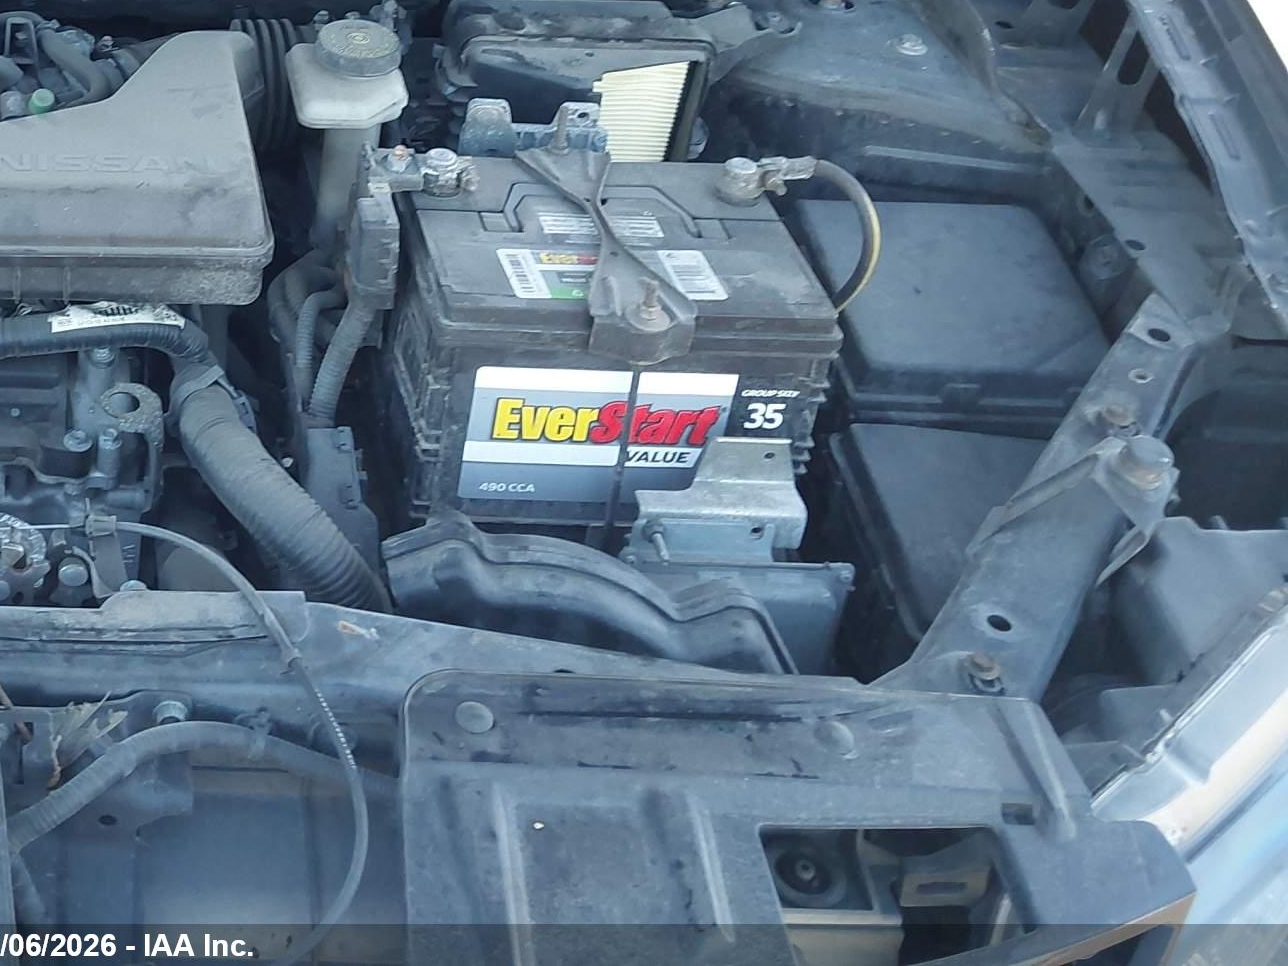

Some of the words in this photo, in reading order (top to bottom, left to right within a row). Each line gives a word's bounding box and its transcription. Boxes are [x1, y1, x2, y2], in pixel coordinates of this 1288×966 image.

[492, 396, 722, 447] EverStart
[744, 402, 787, 429] 35
[625, 450, 691, 464] VALUE
[478, 482, 506, 492] 490
[508, 482, 536, 492] CCA
